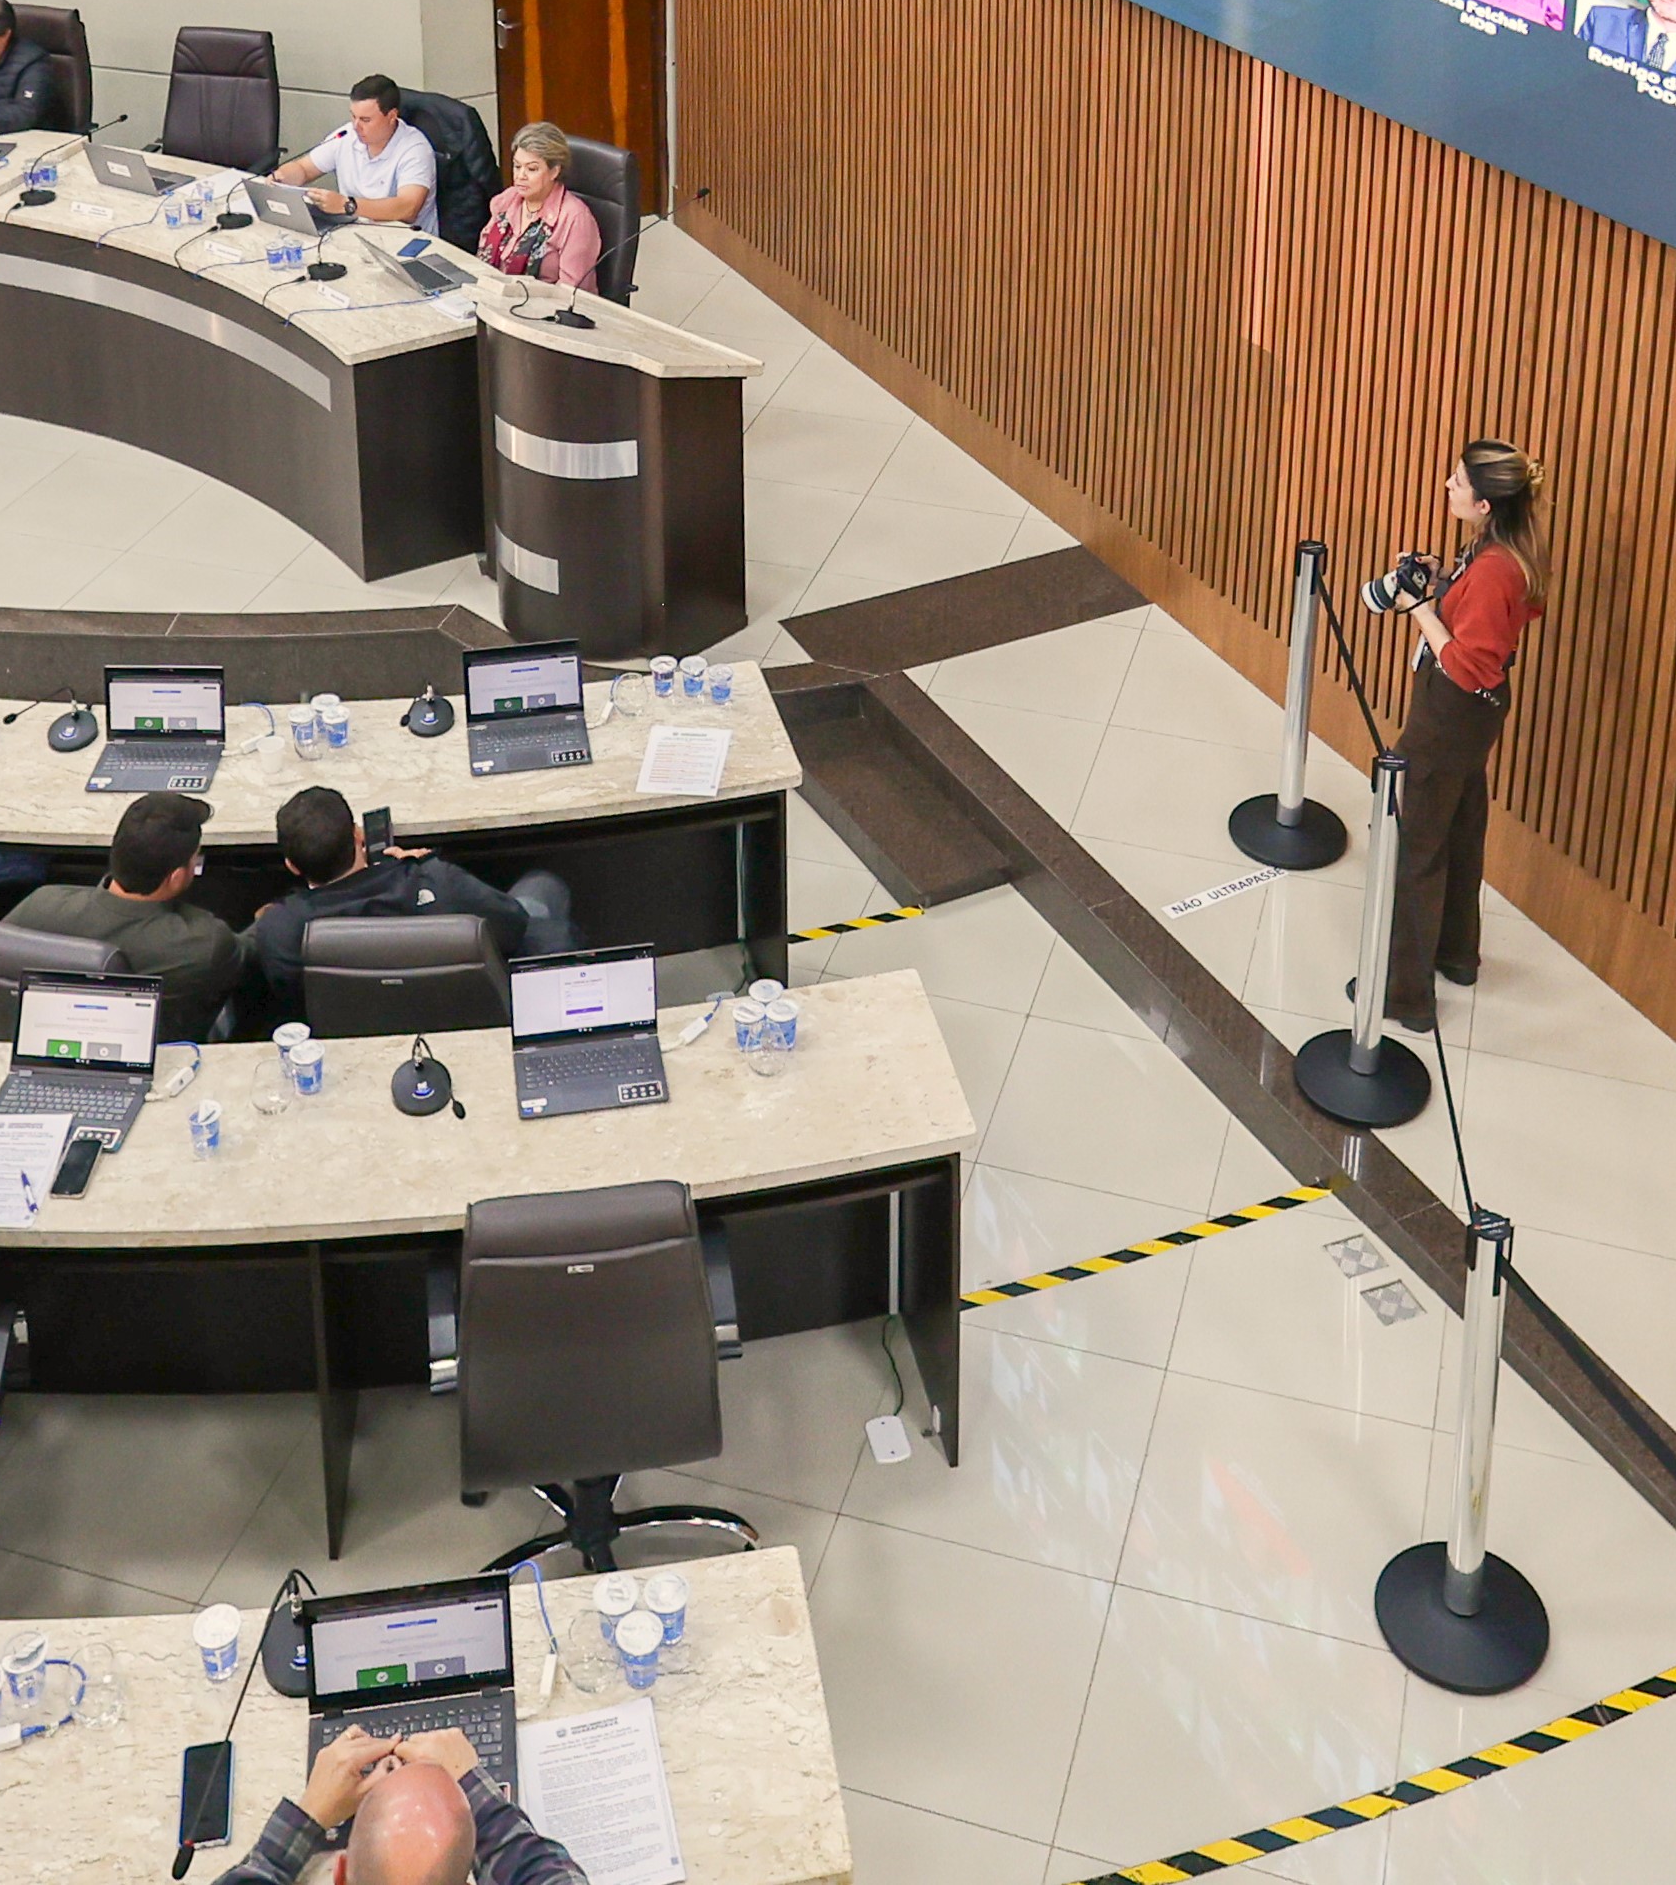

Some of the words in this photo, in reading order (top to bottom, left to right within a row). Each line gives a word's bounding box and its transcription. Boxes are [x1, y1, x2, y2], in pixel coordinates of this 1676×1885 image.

[1459, 12, 1497, 36] MDB
[1465, 0, 1529, 36] Felchak
[1587, 45, 1661, 87] Rodrigo
[1170, 896, 1202, 915] NÃO
[1206, 866, 1286, 901] ULTRAPASSE
